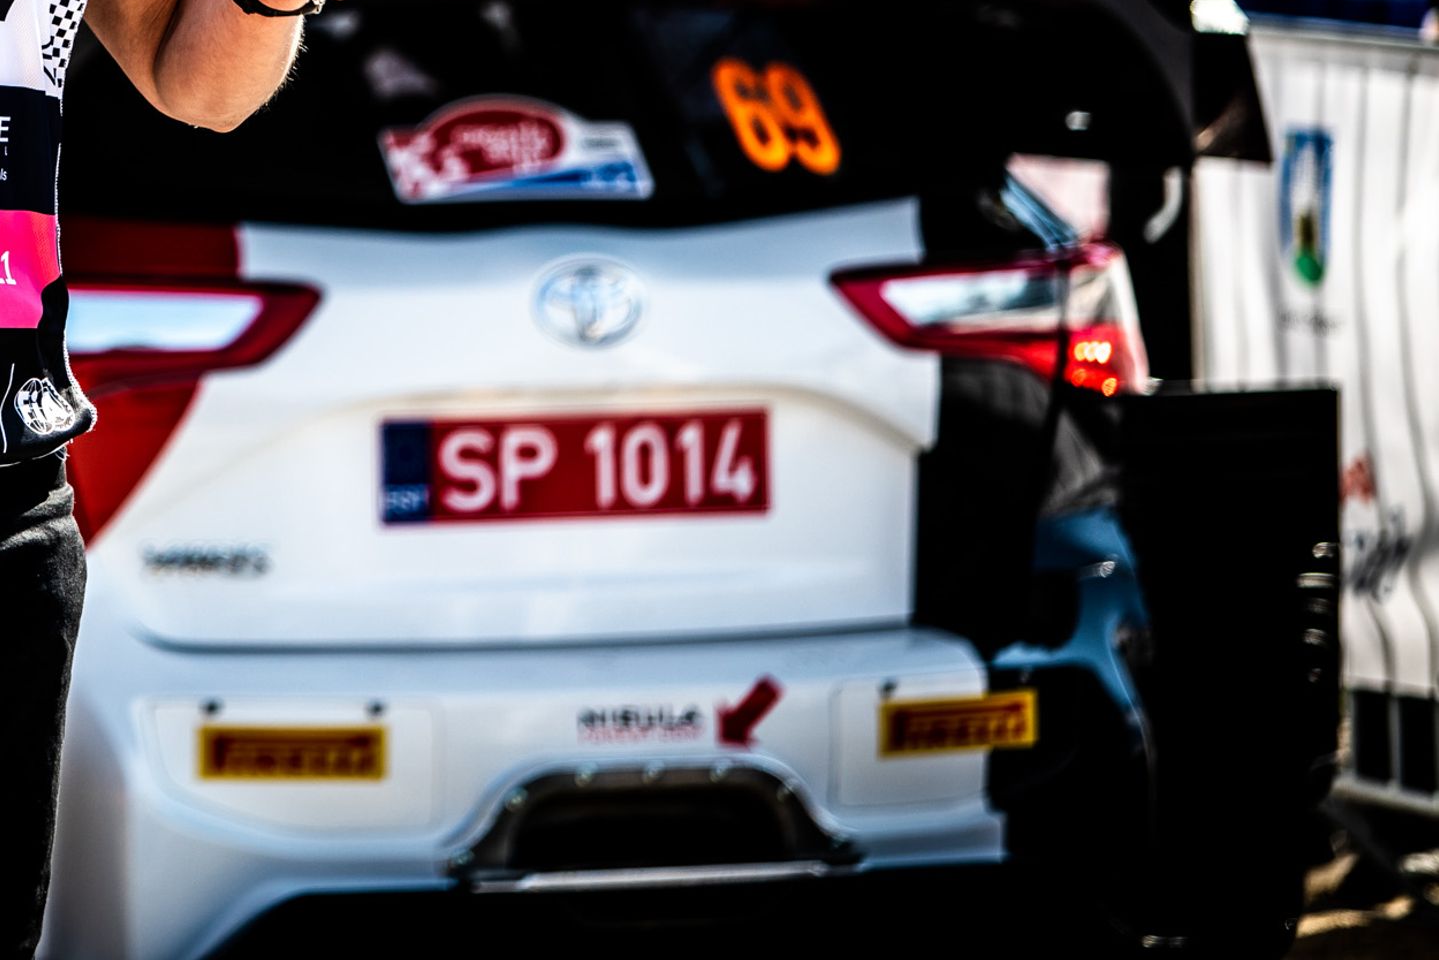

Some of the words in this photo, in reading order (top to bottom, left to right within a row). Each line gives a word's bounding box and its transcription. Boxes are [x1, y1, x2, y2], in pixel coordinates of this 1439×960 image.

[713, 59, 841, 174] 69
[438, 423, 559, 512] SP
[583, 418, 757, 509] 1014
